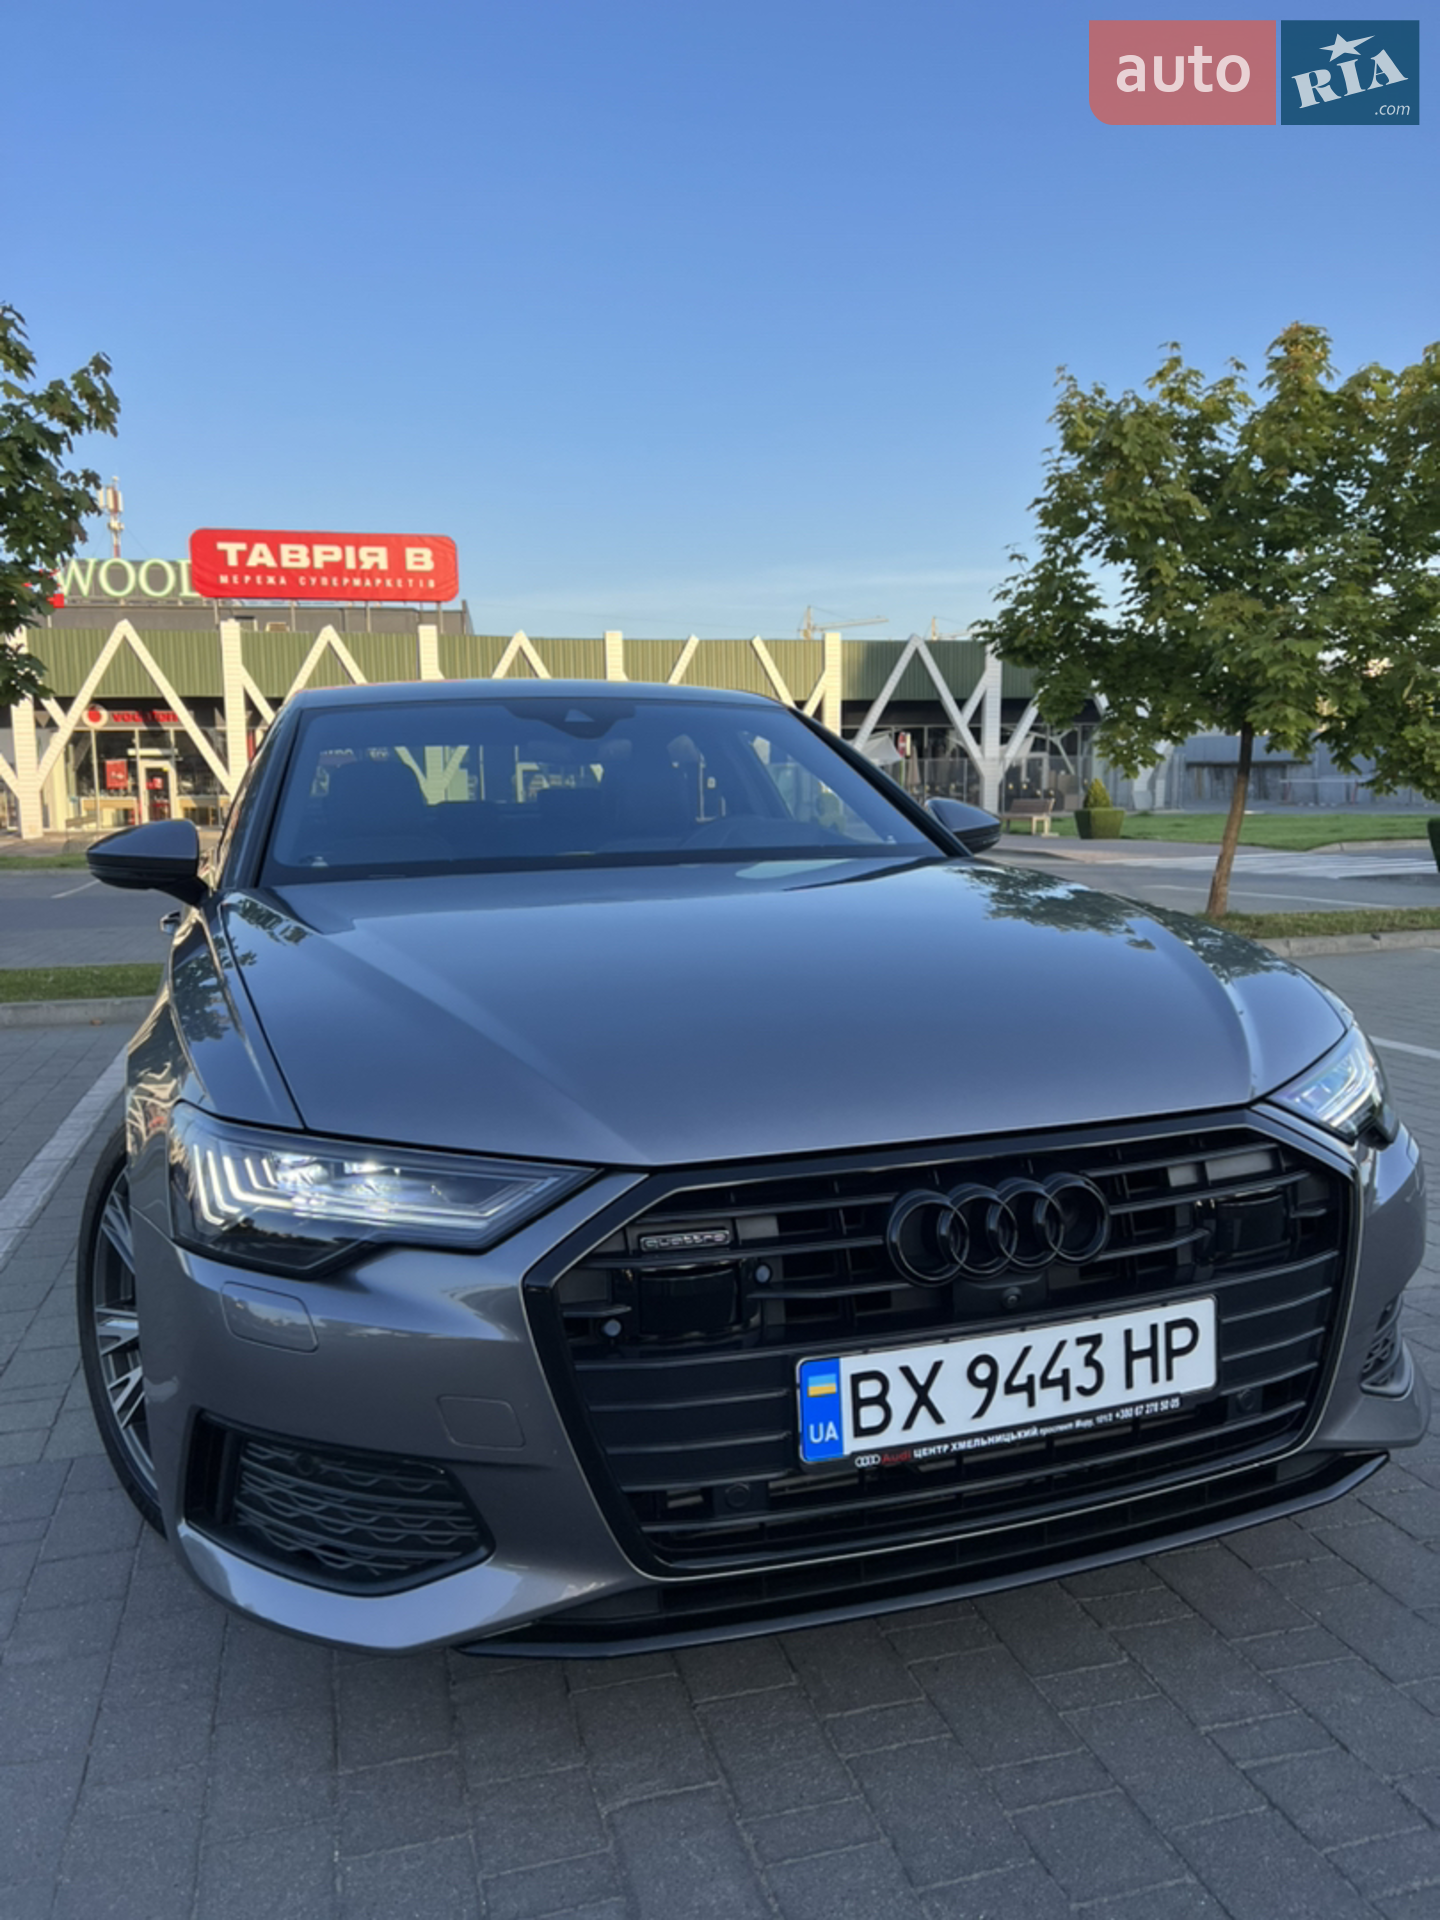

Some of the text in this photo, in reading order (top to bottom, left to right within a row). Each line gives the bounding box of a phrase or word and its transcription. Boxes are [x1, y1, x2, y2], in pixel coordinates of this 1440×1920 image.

[216, 541, 435, 572] ТАВРІЯ В
[217, 574, 436, 588] МЕРЕЖА СУПЕРМАРКЕТІВ
[112, 709, 178, 723] vodfon
[849, 1316, 1201, 1439] BX 9443 HP
[808, 1421, 839, 1444] UA
[882, 1450, 912, 1465] Audi
[913, 1444, 950, 1459] ЦЕНТР
[950, 1425, 1039, 1453] ХМЕЛЬНИЦЬКИЙ
